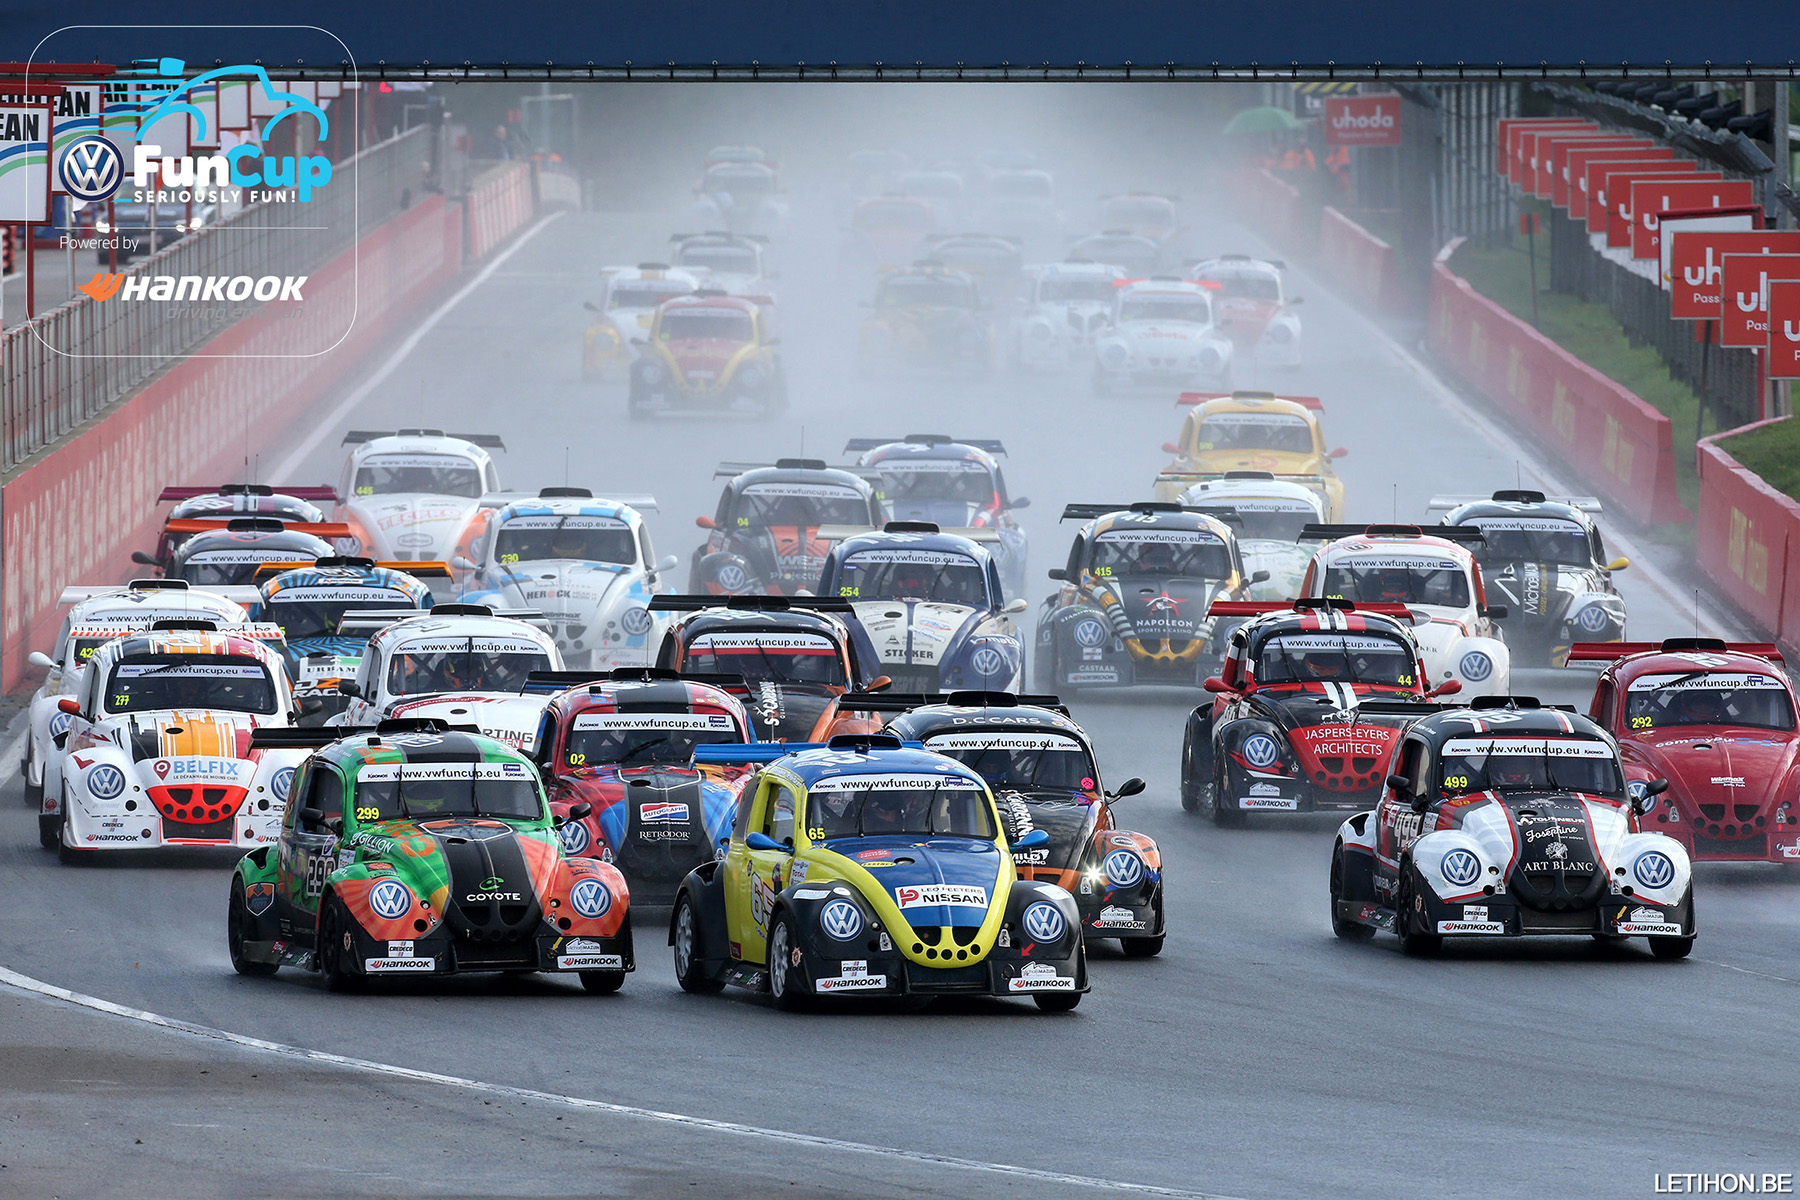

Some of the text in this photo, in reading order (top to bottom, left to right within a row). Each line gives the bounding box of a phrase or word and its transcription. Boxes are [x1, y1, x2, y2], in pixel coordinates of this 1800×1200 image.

[1333, 105, 1394, 128] uhoda
[356, 486, 374, 496] 445
[764, 487, 841, 497] www.vwfuncup.eu
[526, 520, 607, 530] www.vwfuncup.eu
[1480, 522, 1561, 531] www.vwfuncup.eu
[1120, 534, 1201, 543] www.vwfuncup.eu
[211, 555, 297, 563] www.vwfuncup.eu
[871, 552, 955, 564] www.vwfuncup.eu
[1354, 560, 1438, 569] www.vwfuncup.eu
[1095, 567, 1112, 577] 415
[295, 591, 384, 601] www.vwfuncup.eu
[840, 587, 860, 597] 254
[1136, 619, 1193, 628] NAPOLEON
[422, 642, 517, 652] www.vwfuncup.eu
[712, 637, 807, 648] www.vwfuncup.eu
[1287, 640, 1380, 649] www.vwfuncup.eu
[143, 666, 238, 676] www.vwfuncup.eu
[1398, 674, 1413, 686] 44
[1659, 678, 1757, 689] www.vwfuncup.eu
[115, 695, 130, 706] 277
[604, 718, 707, 730] www.vwfuncup.eu
[988, 716, 1041, 725] CARS
[1631, 716, 1653, 729] 292
[1305, 727, 1391, 741] JASPERS-EYERS
[949, 739, 1054, 750] www.vwfuncup.eu
[1313, 742, 1383, 756] ARCHITECTS
[1476, 744, 1580, 756] www.vwfuncup.eu
[570, 753, 586, 765] 02
[173, 760, 239, 776] BELFIX
[393, 768, 501, 781] www.vwfuncup.eu
[841, 778, 949, 789] www.vwfuncup.eu
[1444, 776, 1468, 788] 499
[356, 808, 380, 820] 299
[643, 806, 688, 818] AUTOGRAPHE
[639, 830, 690, 838] RETRODOR
[807, 827, 826, 841] 65
[1525, 825, 1579, 844] Josephine
[1523, 861, 1594, 872] ART BLANC
[466, 892, 521, 902] COYOTE
[923, 894, 985, 906] NISSAN
